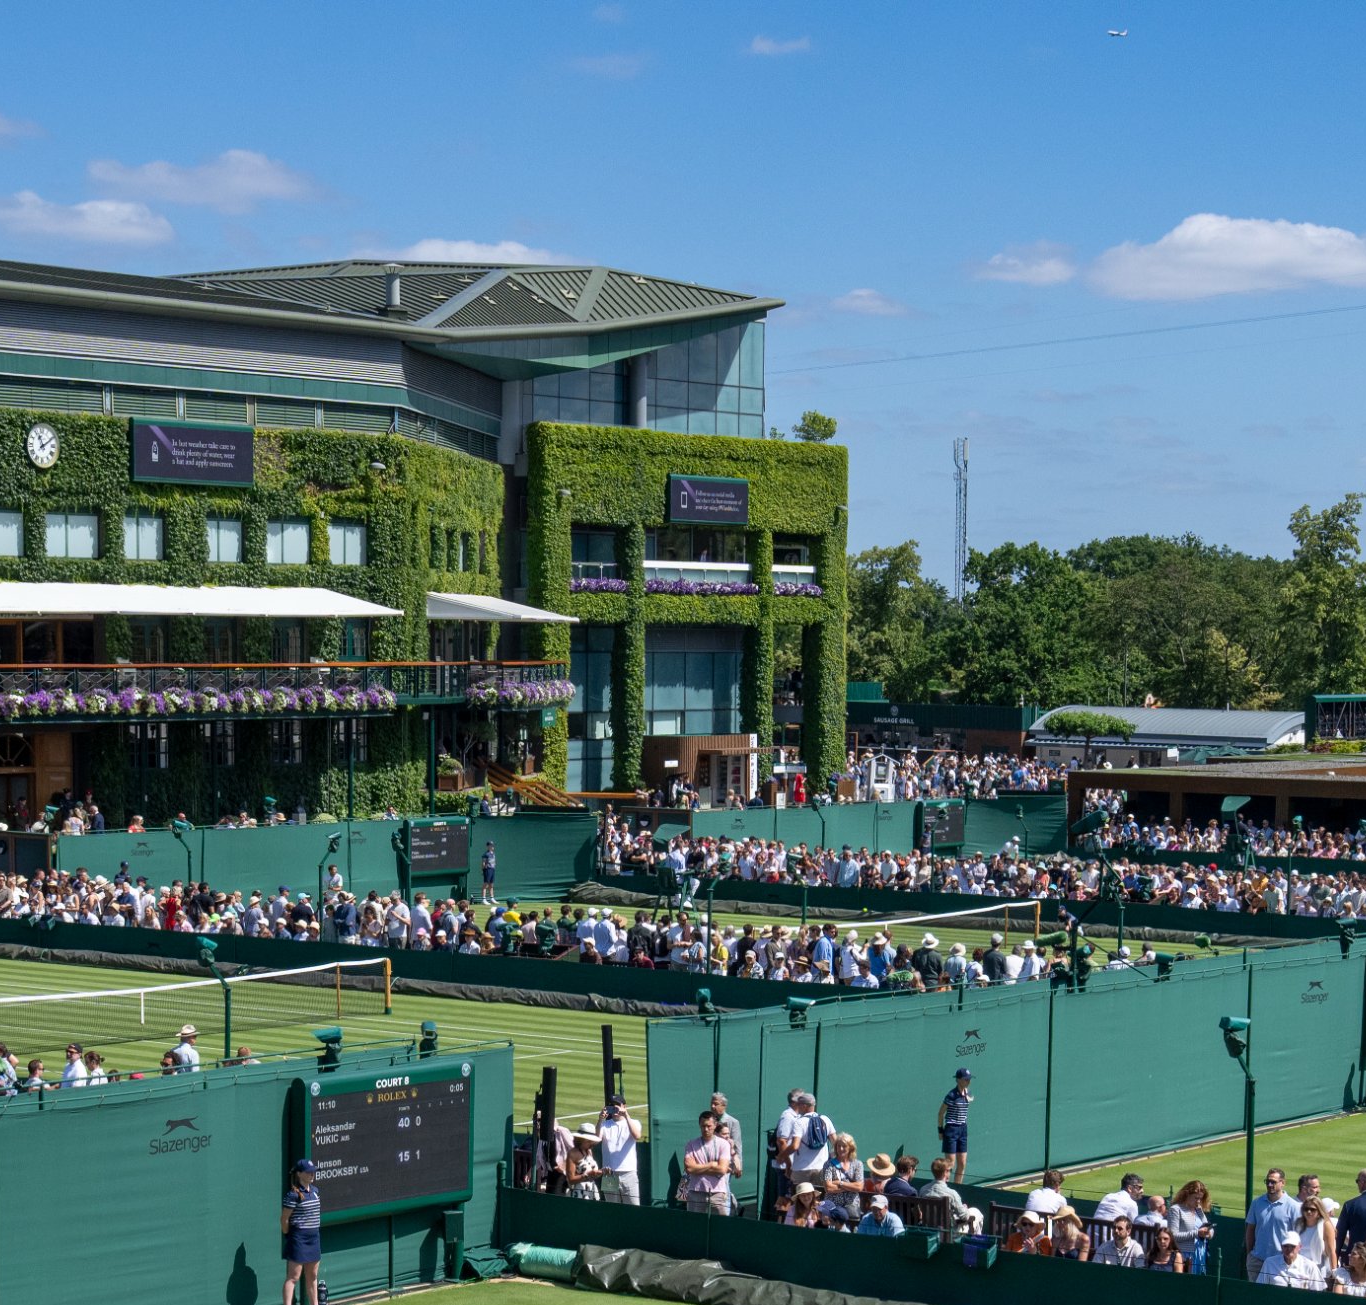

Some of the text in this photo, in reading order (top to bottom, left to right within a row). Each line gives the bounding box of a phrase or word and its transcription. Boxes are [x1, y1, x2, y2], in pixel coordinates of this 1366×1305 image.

[179, 439, 188, 447] hot
[188, 441, 208, 449] weather
[208, 441, 219, 449] take
[172, 447, 185, 456] drink
[186, 449, 202, 459] plenty
[202, 450, 209, 458] of
[195, 459, 209, 468] apply
[955, 1043, 987, 1057] Slazenger
[376, 1076, 410, 1089] COURT 8
[449, 1083, 464, 1093] 0:05
[378, 1090, 407, 1102] ROLEX
[318, 1100, 336, 1110] 11:10
[315, 1121, 355, 1135] Aleksandar
[398, 1116, 421, 1128] 40 0
[149, 1135, 212, 1155] Slazenger
[315, 1134, 339, 1146] VUKIC
[398, 1150, 420, 1162] 15 1
[315, 1159, 342, 1169] Jenson
[315, 1166, 358, 1181] BROOKSBY
